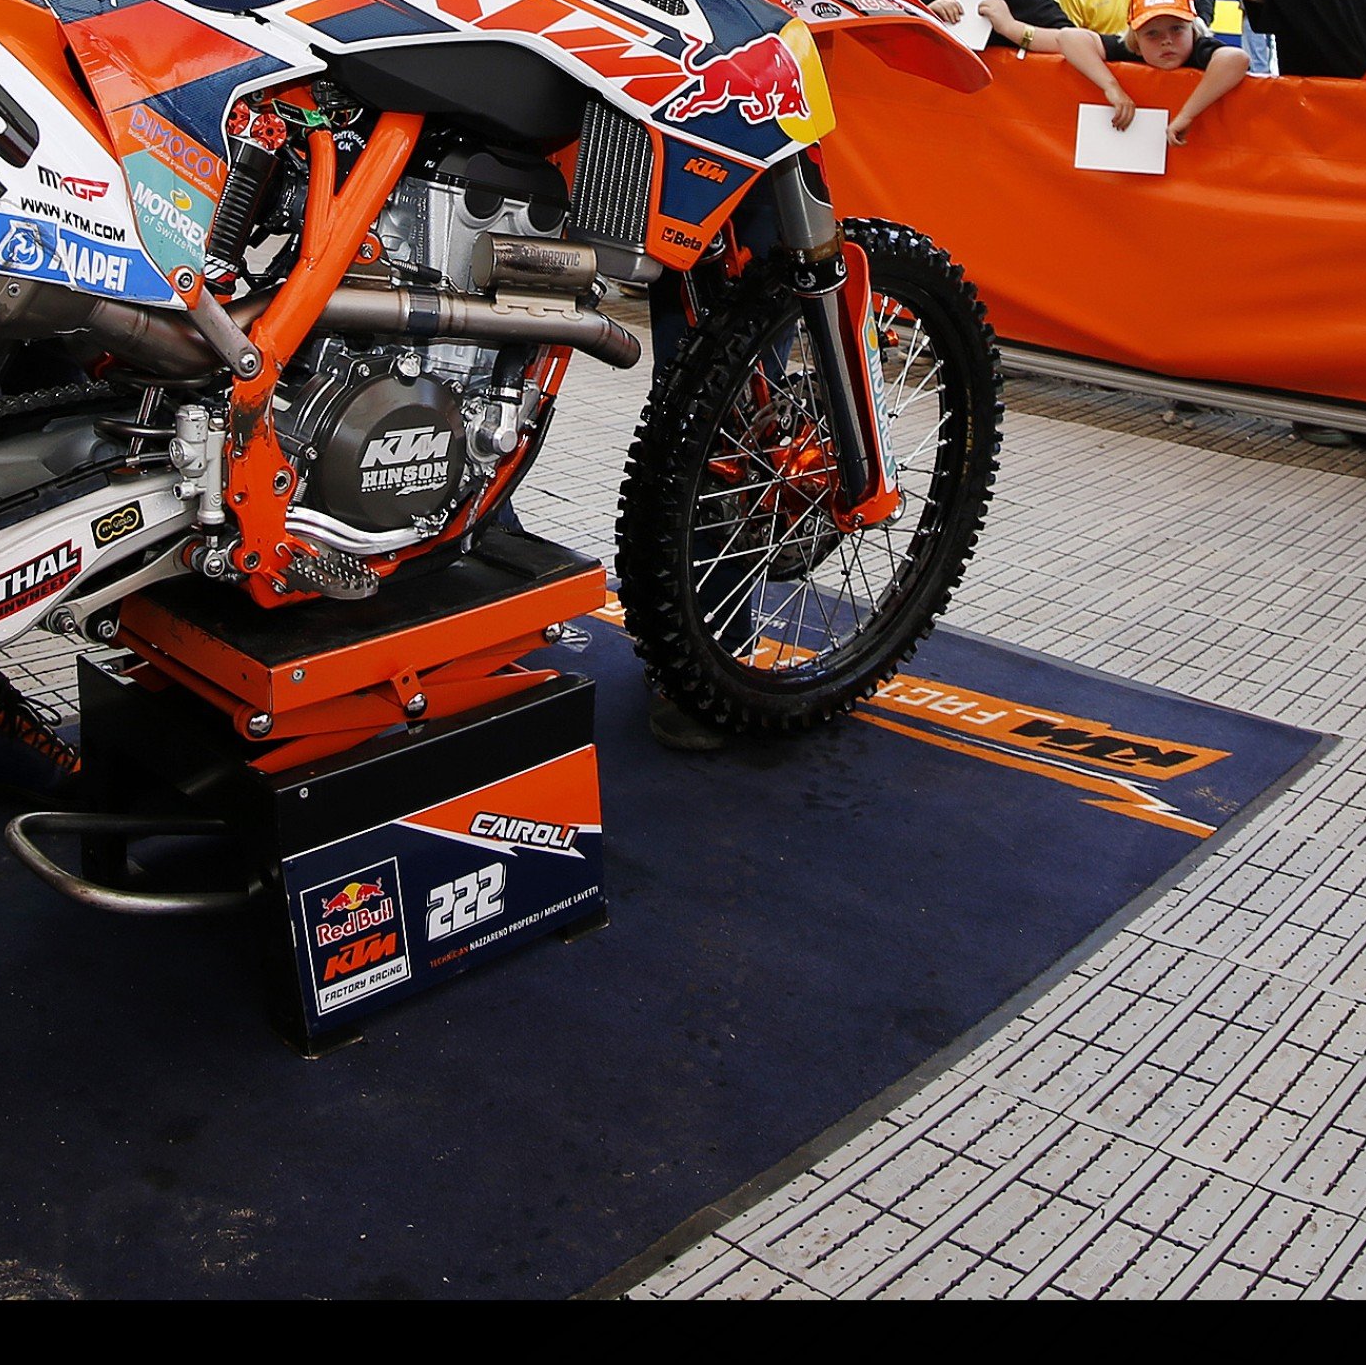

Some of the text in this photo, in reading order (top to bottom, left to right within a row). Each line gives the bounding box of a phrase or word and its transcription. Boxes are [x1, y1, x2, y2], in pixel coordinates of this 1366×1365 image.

[130, 106, 214, 179] DIMOCO
[683, 157, 729, 184] KTM
[132, 181, 209, 247] MOTOREX
[47, 237, 129, 293] MAPEI
[673, 232, 703, 252] Beta
[359, 425, 452, 469] KTM
[361, 460, 449, 488] HINSON
[1011, 718, 1199, 769] KTM
[470, 813, 577, 849] CAIROLI
[315, 897, 395, 947] Red Bull
[426, 861, 507, 942] 222
[469, 926, 509, 950] NAZZARENO
[508, 911, 540, 934] PROPERZI
[544, 895, 573, 918] MICHELE
[573, 885, 600, 904] LAVETTI
[323, 932, 398, 982] KTM
[324, 979, 367, 1003] FACTORY
